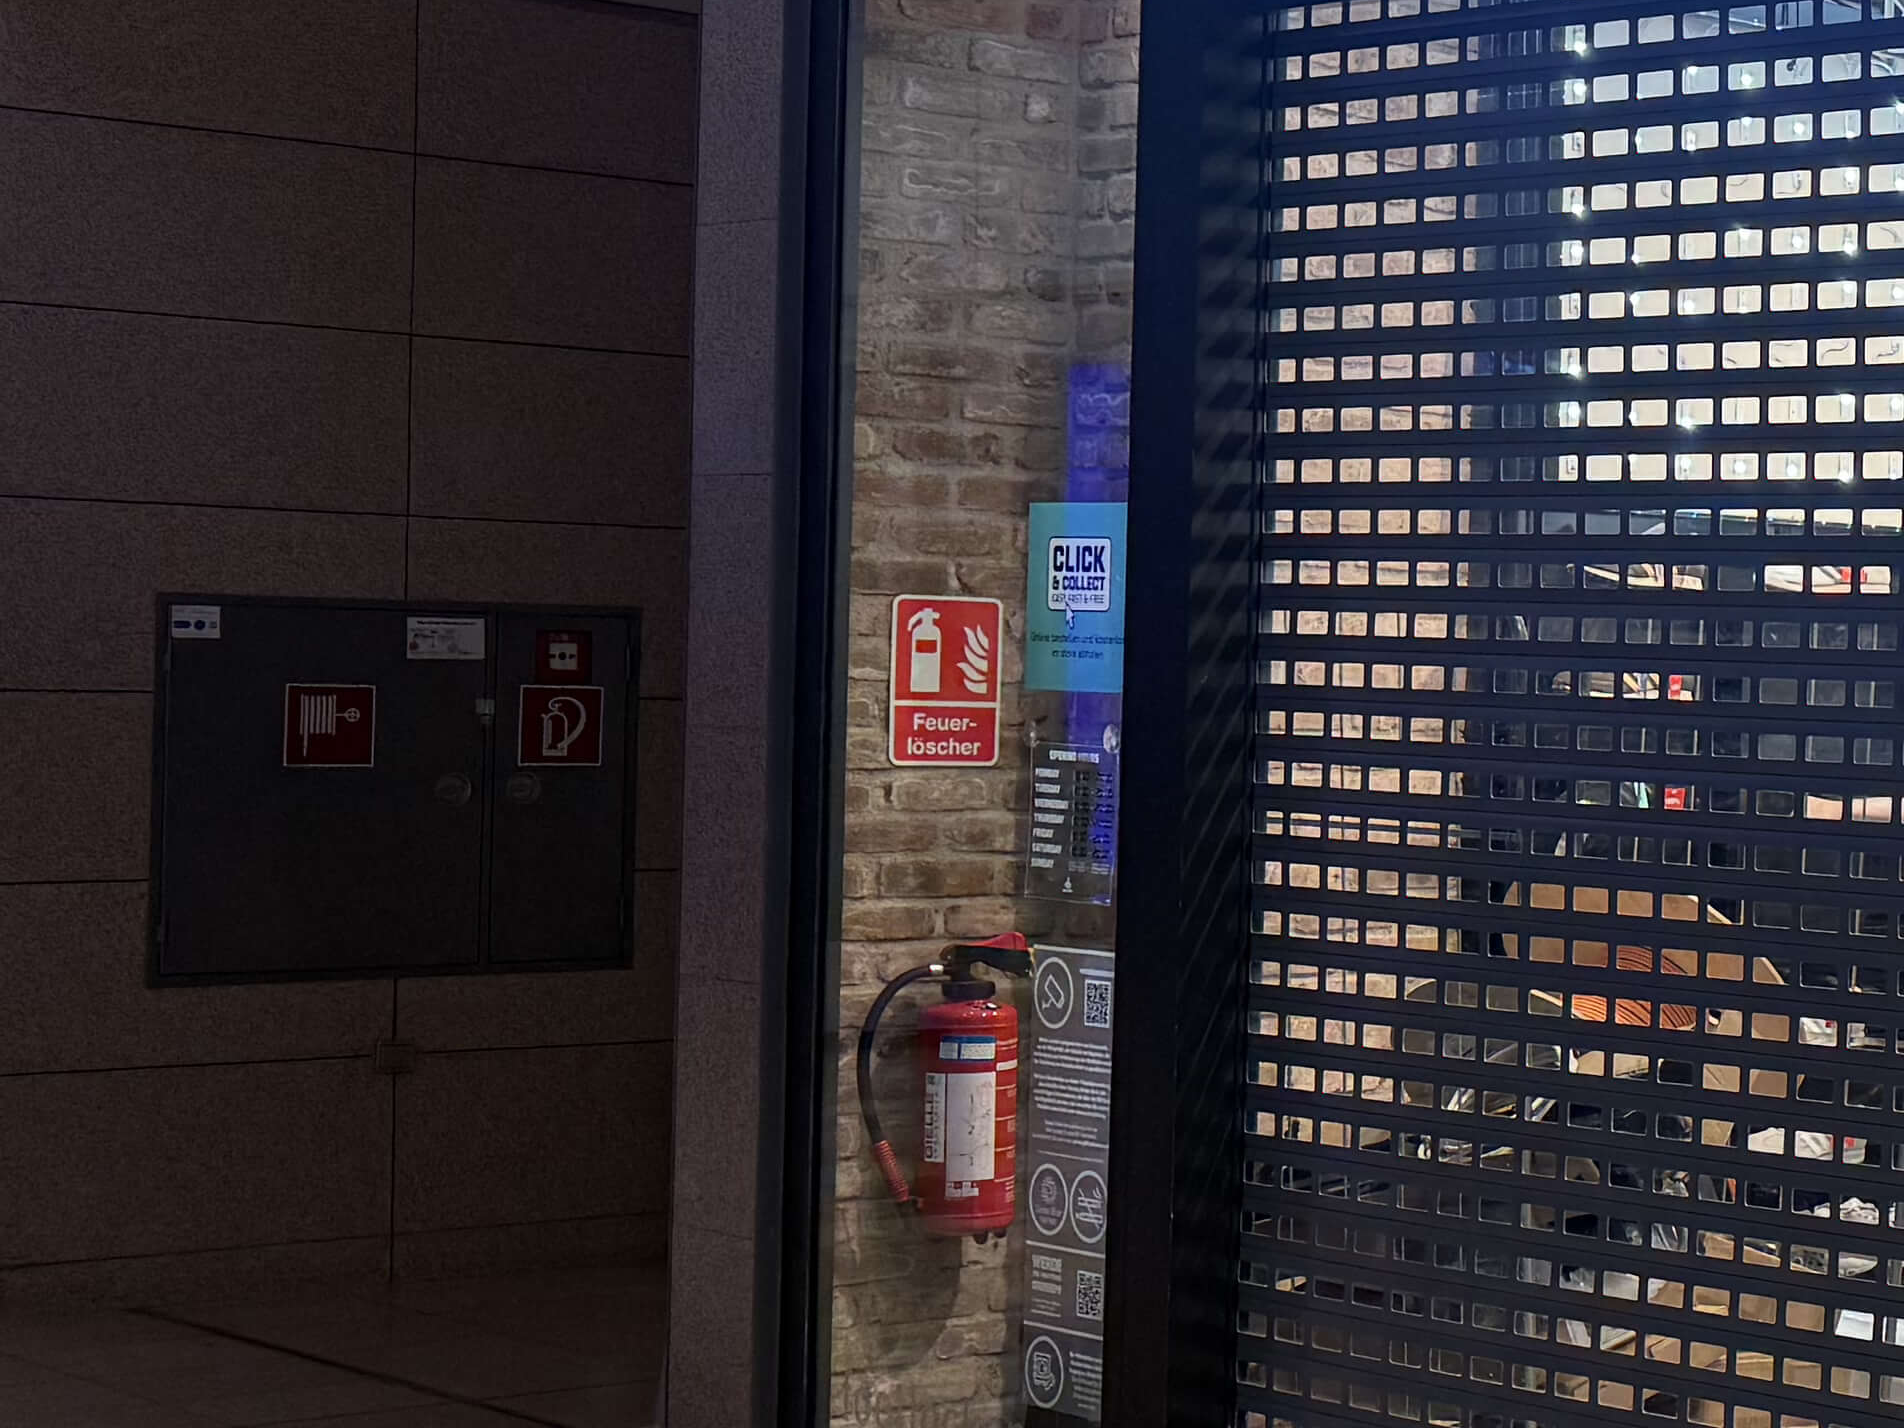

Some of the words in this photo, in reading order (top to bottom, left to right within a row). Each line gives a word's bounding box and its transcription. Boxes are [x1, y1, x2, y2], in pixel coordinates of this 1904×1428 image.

[1053, 545, 1105, 573] CLICK
[1063, 575, 1106, 591] COLLECT
[912, 713, 978, 734] Feuer-
[906, 736, 981, 758] löscher
